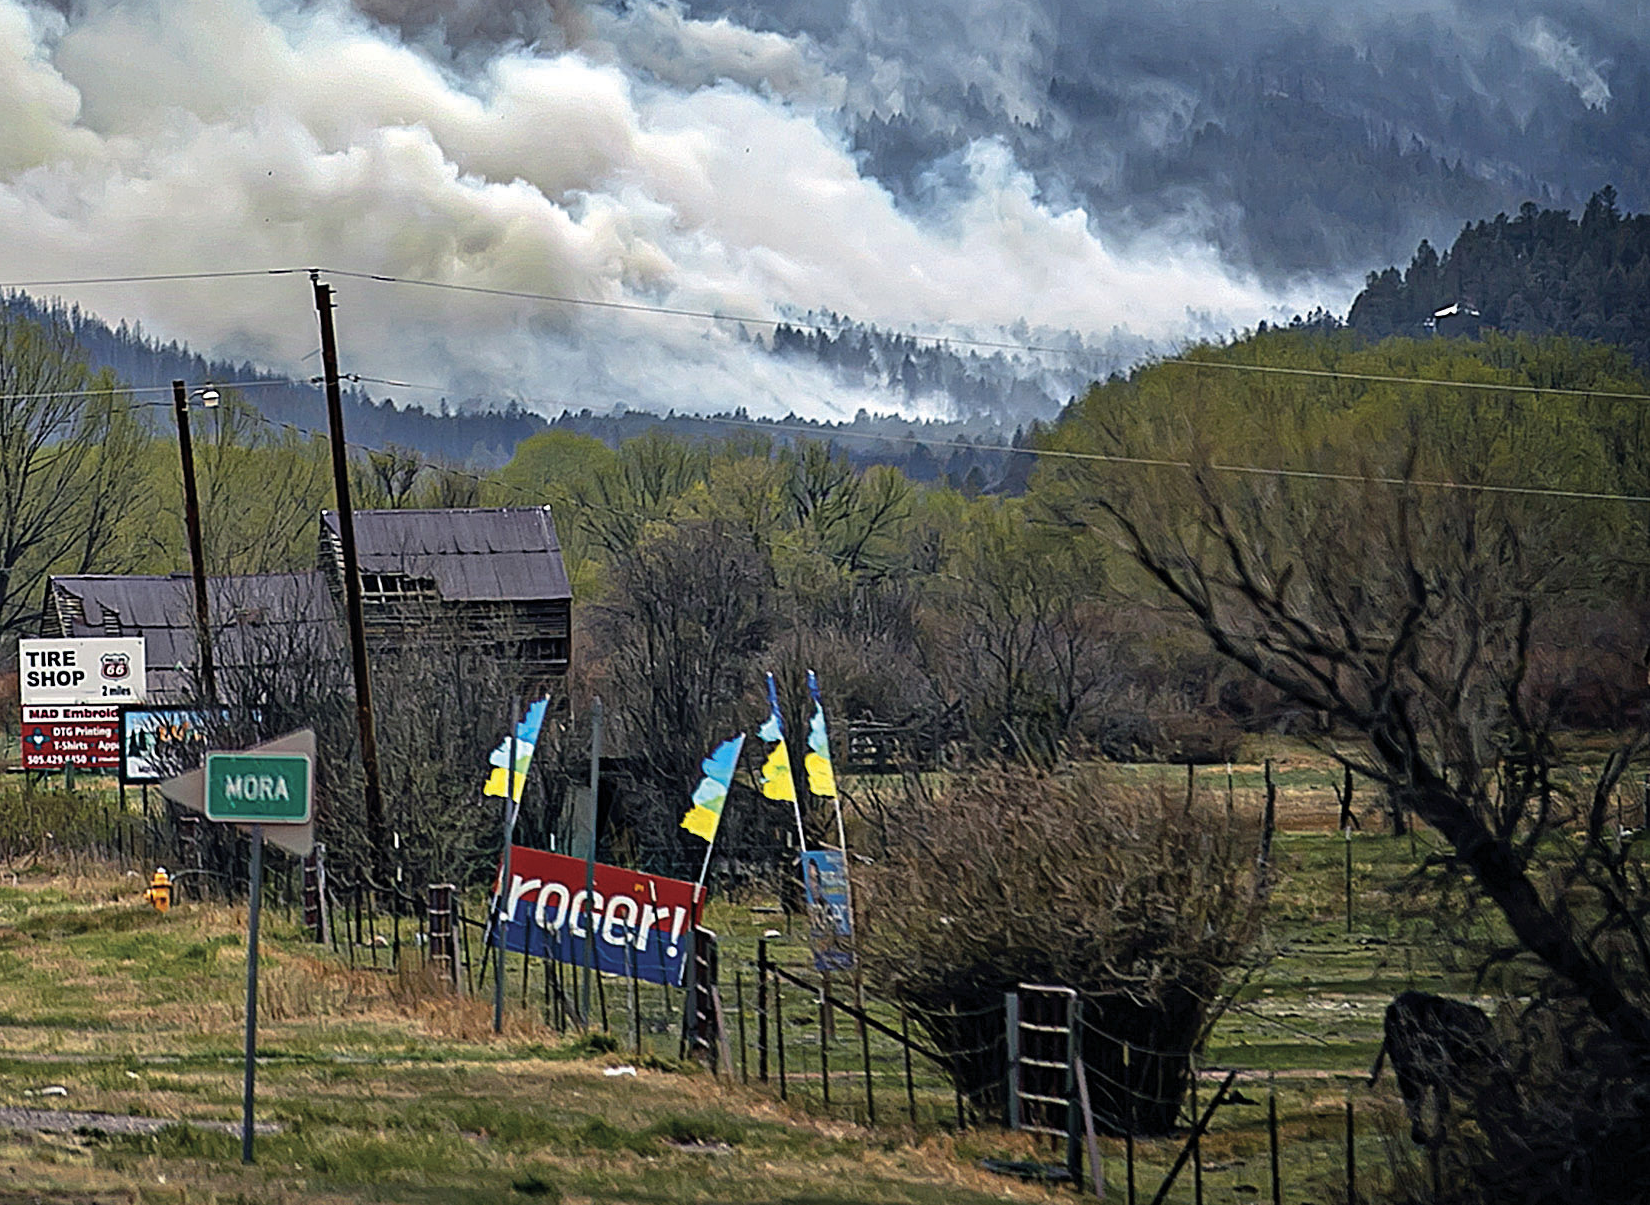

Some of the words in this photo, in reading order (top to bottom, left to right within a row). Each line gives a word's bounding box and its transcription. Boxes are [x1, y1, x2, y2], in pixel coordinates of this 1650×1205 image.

[25, 650, 76, 667] TIRE
[106, 664, 125, 676] 66
[27, 670, 85, 687] SHOP
[102, 685, 108, 696] 2
[109, 685, 131, 696] miles
[29, 709, 59, 719] MAD
[52, 726, 73, 737] DTG
[74, 725, 112, 738] Printing
[53, 740, 89, 751] T-Shirts
[224, 774, 290, 802] MORA
